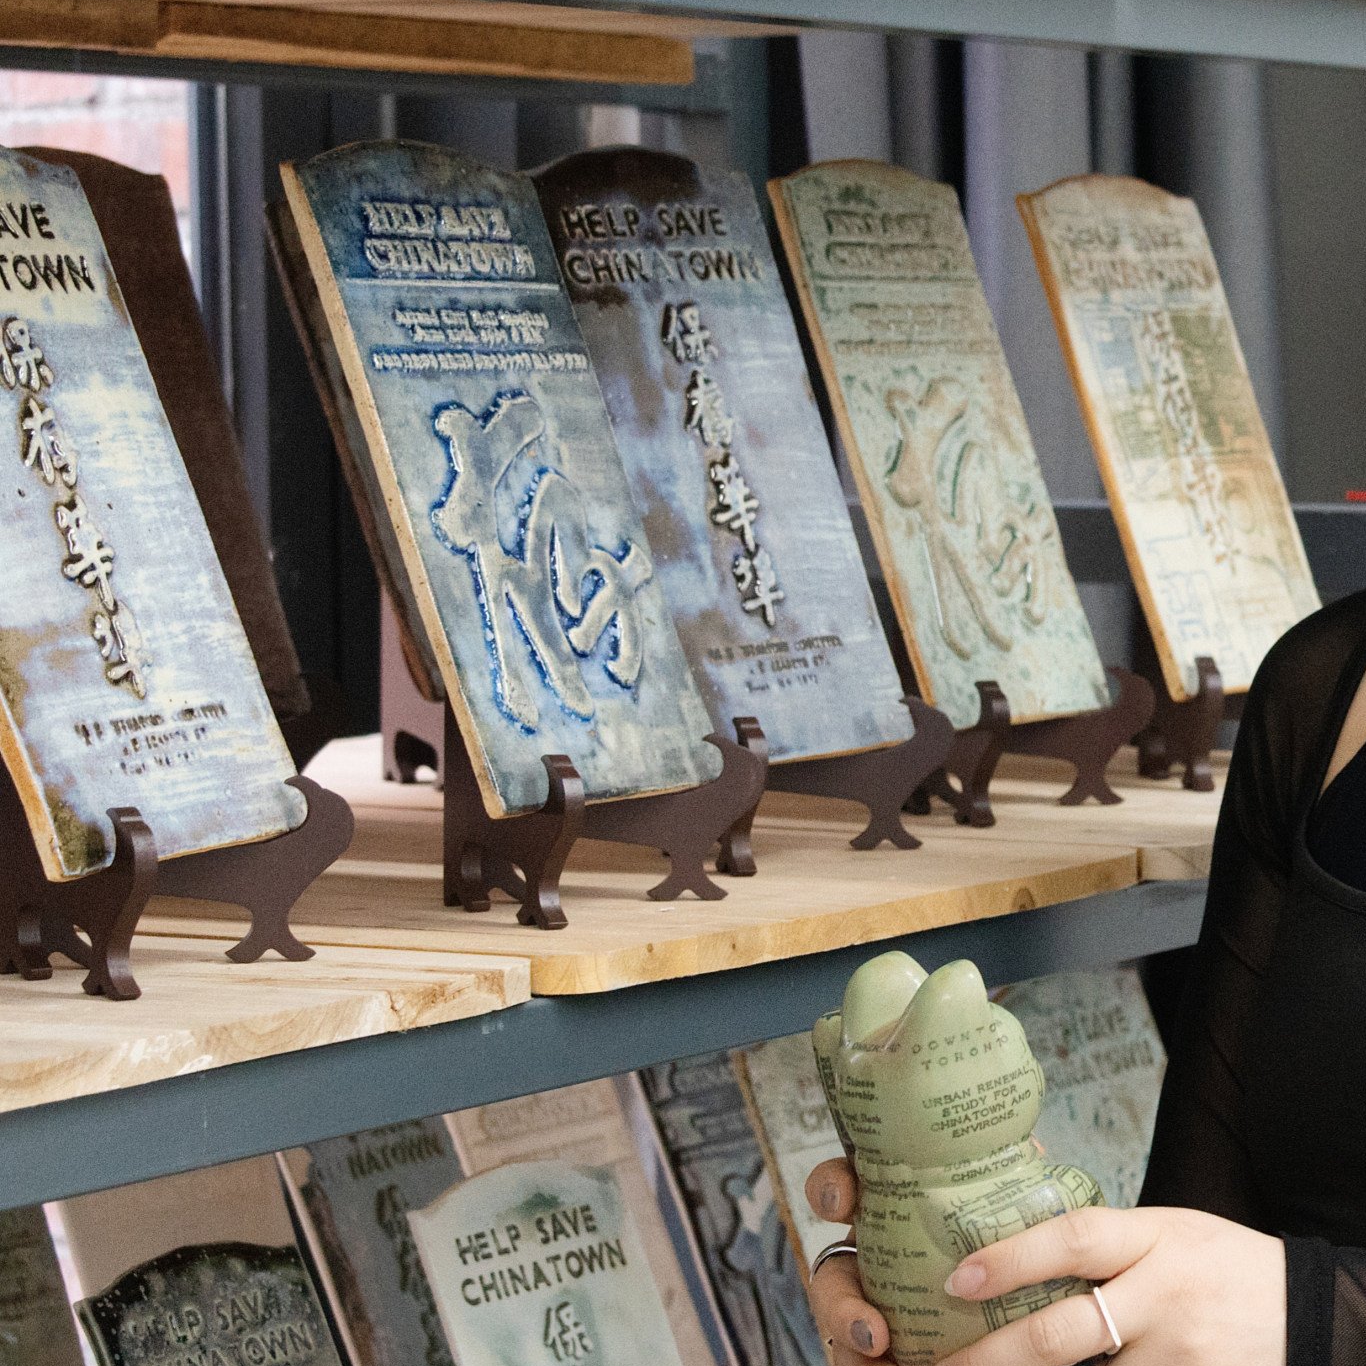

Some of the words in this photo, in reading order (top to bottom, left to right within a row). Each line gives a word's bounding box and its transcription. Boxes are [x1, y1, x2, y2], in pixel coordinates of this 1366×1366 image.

[560, 202, 641, 241] HELP
[655, 201, 728, 238] SAVE
[364, 237, 536, 280] CHINATOWN
[564, 246, 763, 288] CHINATOWN
[922, 1087, 971, 1110] URBAN
[977, 1063, 1029, 1094] RENEWAL
[942, 1094, 987, 1118] STUDY
[993, 1083, 1018, 1101] FOR
[930, 1100, 1006, 1133] CHINATOWN
[1010, 1088, 1032, 1107] AND
[951, 1108, 1019, 1138] ENVIRONS.
[455, 1223, 523, 1266] HELP
[535, 1204, 599, 1246] SAVE
[459, 1238, 628, 1307] CHINATOWN
